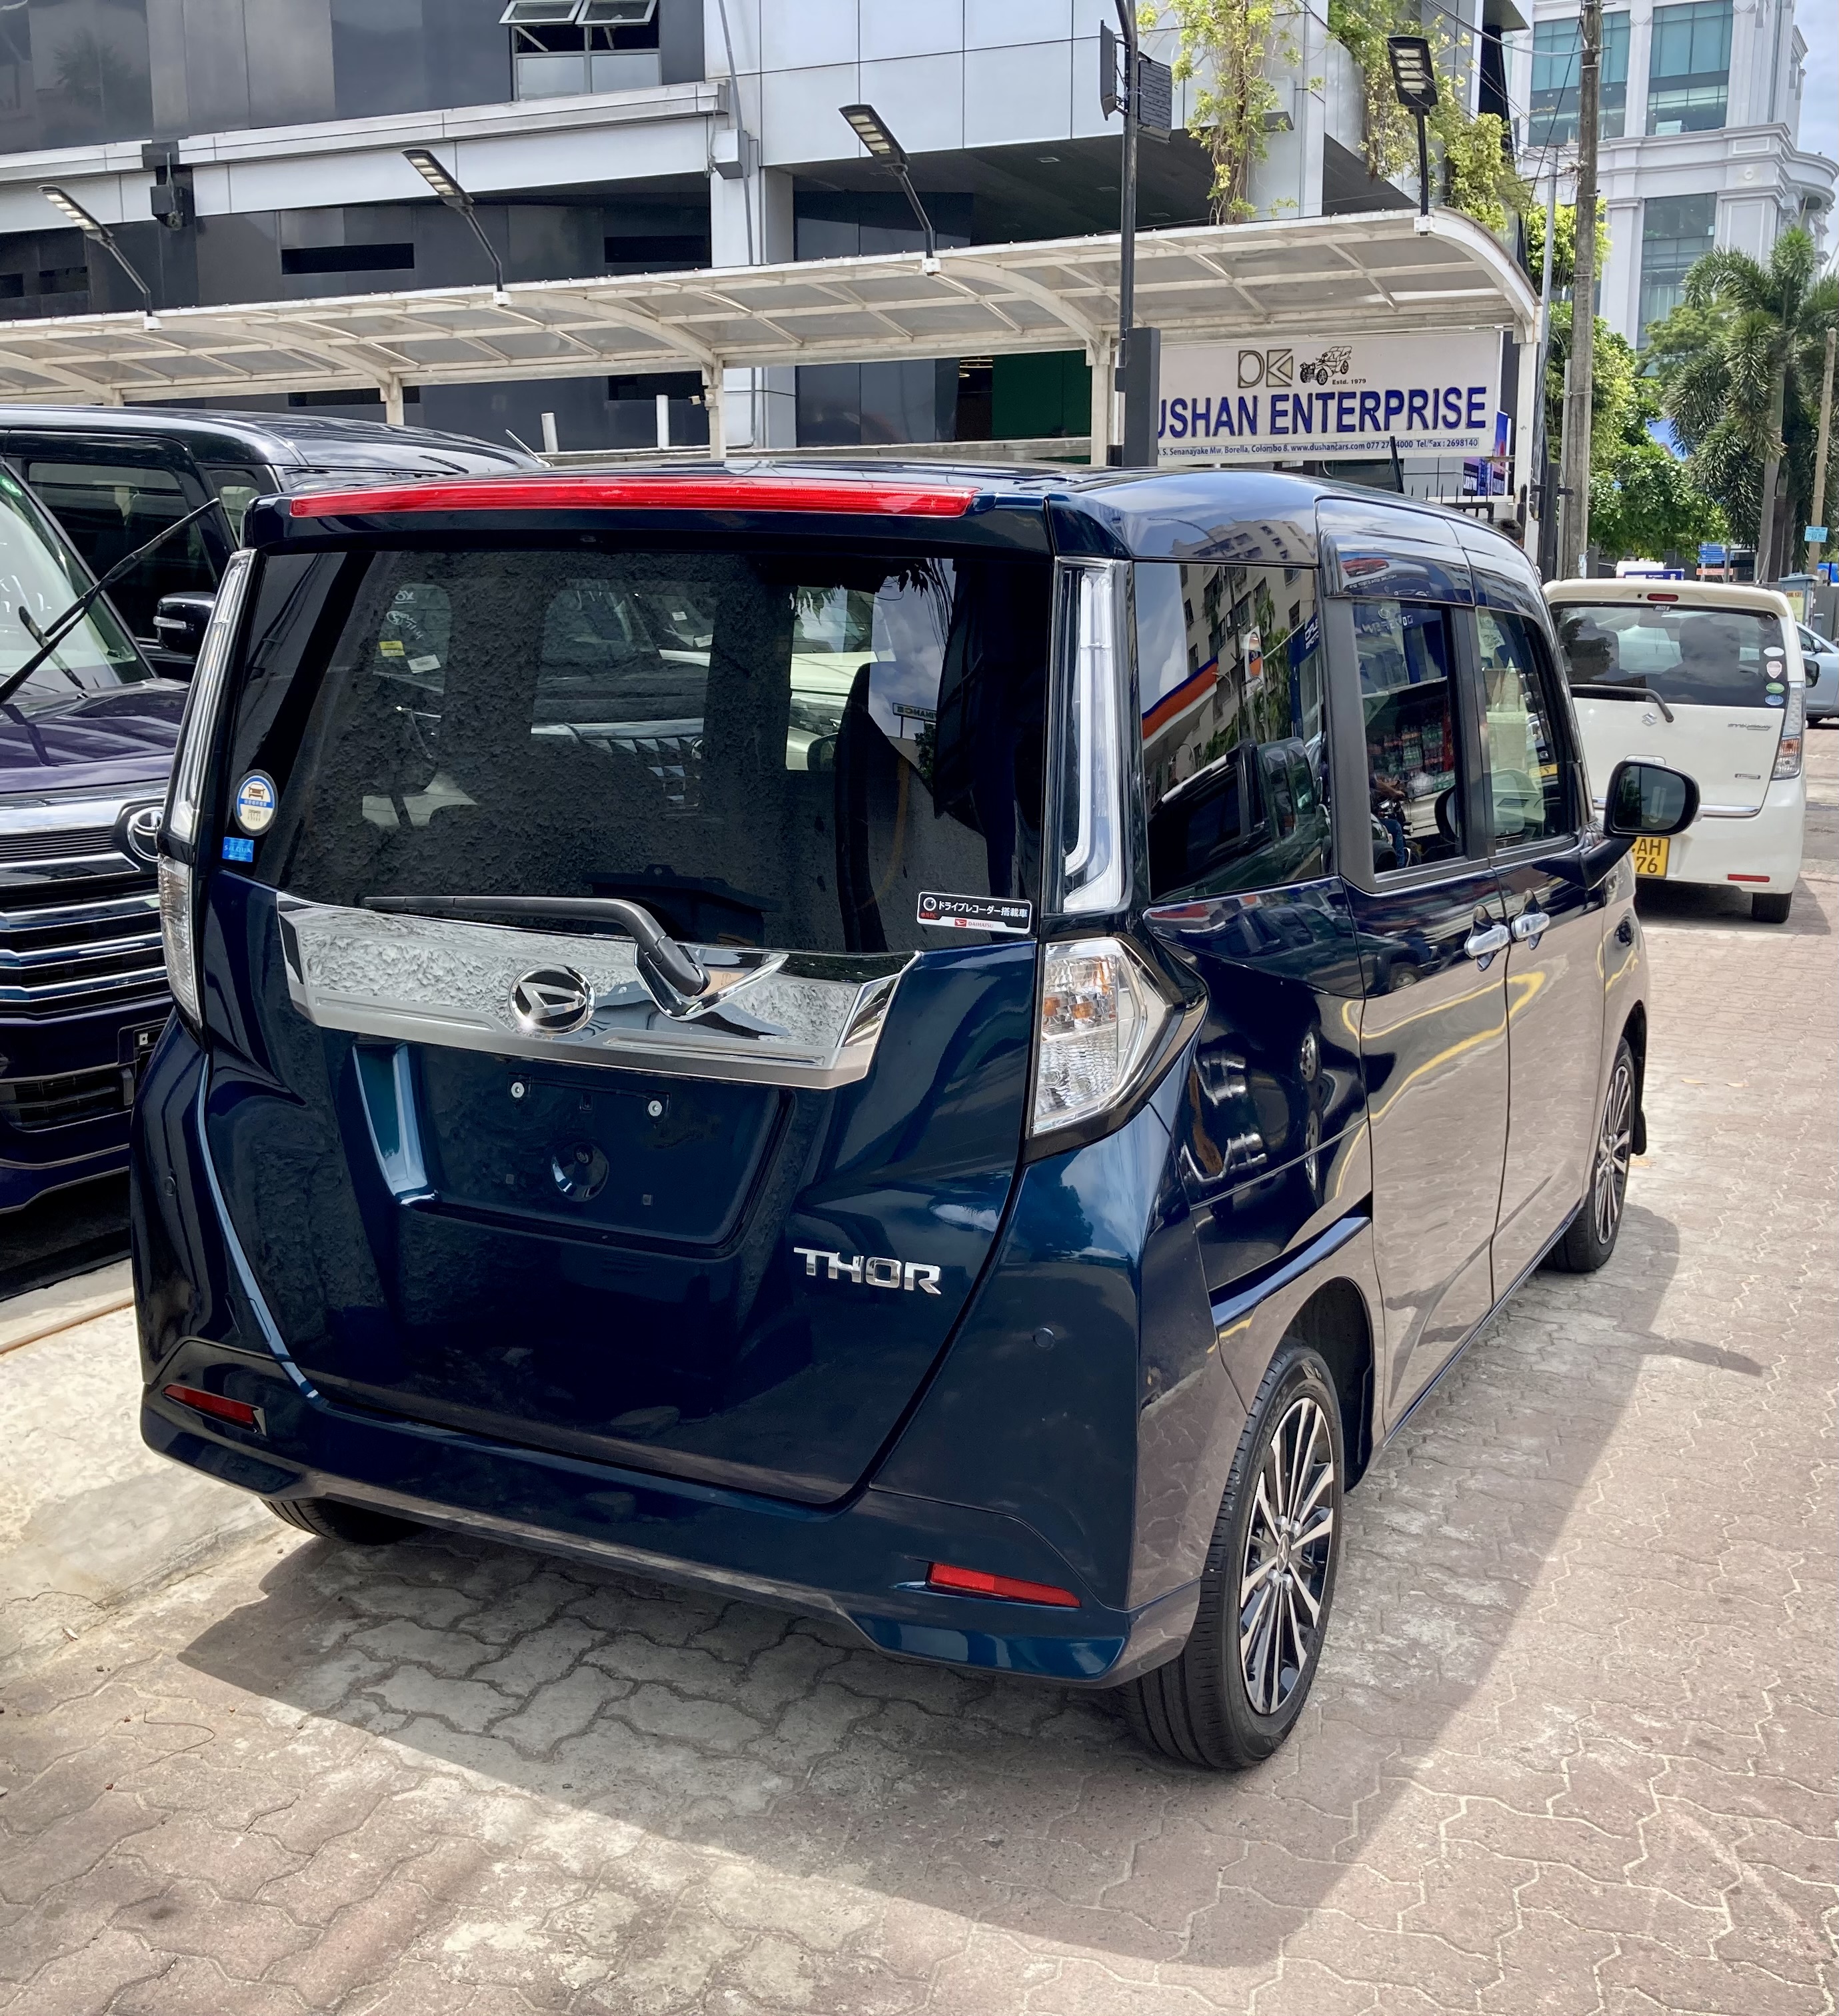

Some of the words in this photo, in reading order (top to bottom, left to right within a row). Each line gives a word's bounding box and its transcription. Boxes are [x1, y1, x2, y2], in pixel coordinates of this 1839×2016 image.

[1270, 387, 1486, 435] ENTERPRISE
[1170, 447, 1208, 457] Senanayake
[1224, 445, 1250, 454] Borella,
[1252, 444, 1282, 453] Colombo
[1290, 442, 1365, 451] www.dushancars.com
[1366, 441, 1380, 449] 077
[1446, 439, 1478, 447] 2698140
[1634, 838, 1662, 856] AH
[938, 900, 1028, 919] ドライブレコーダー搭載車
[793, 1247, 942, 1295] THOR
